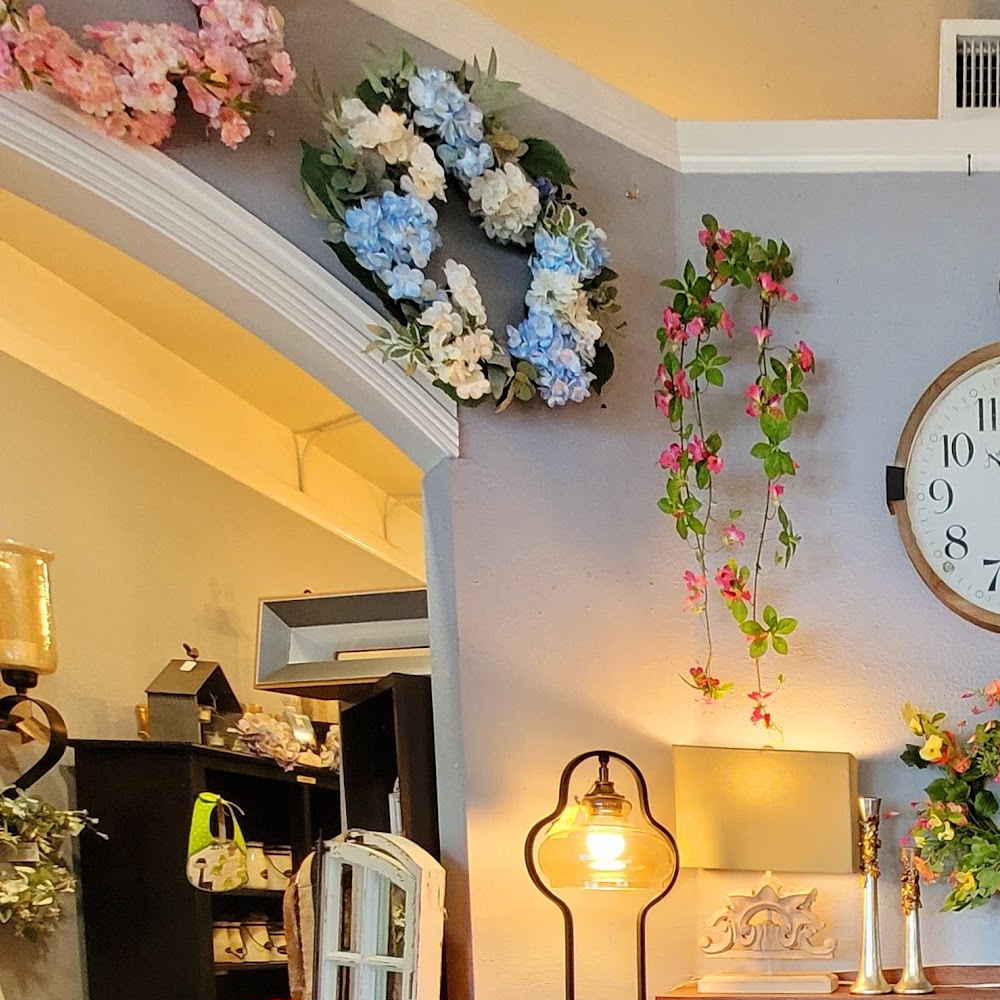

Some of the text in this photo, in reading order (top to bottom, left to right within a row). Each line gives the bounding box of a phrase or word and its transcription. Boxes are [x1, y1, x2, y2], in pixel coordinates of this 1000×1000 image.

[976, 397, 998, 432] 11
[941, 432, 974, 468] 10
[928, 478, 955, 515] 9
[944, 524, 969, 560] 8
